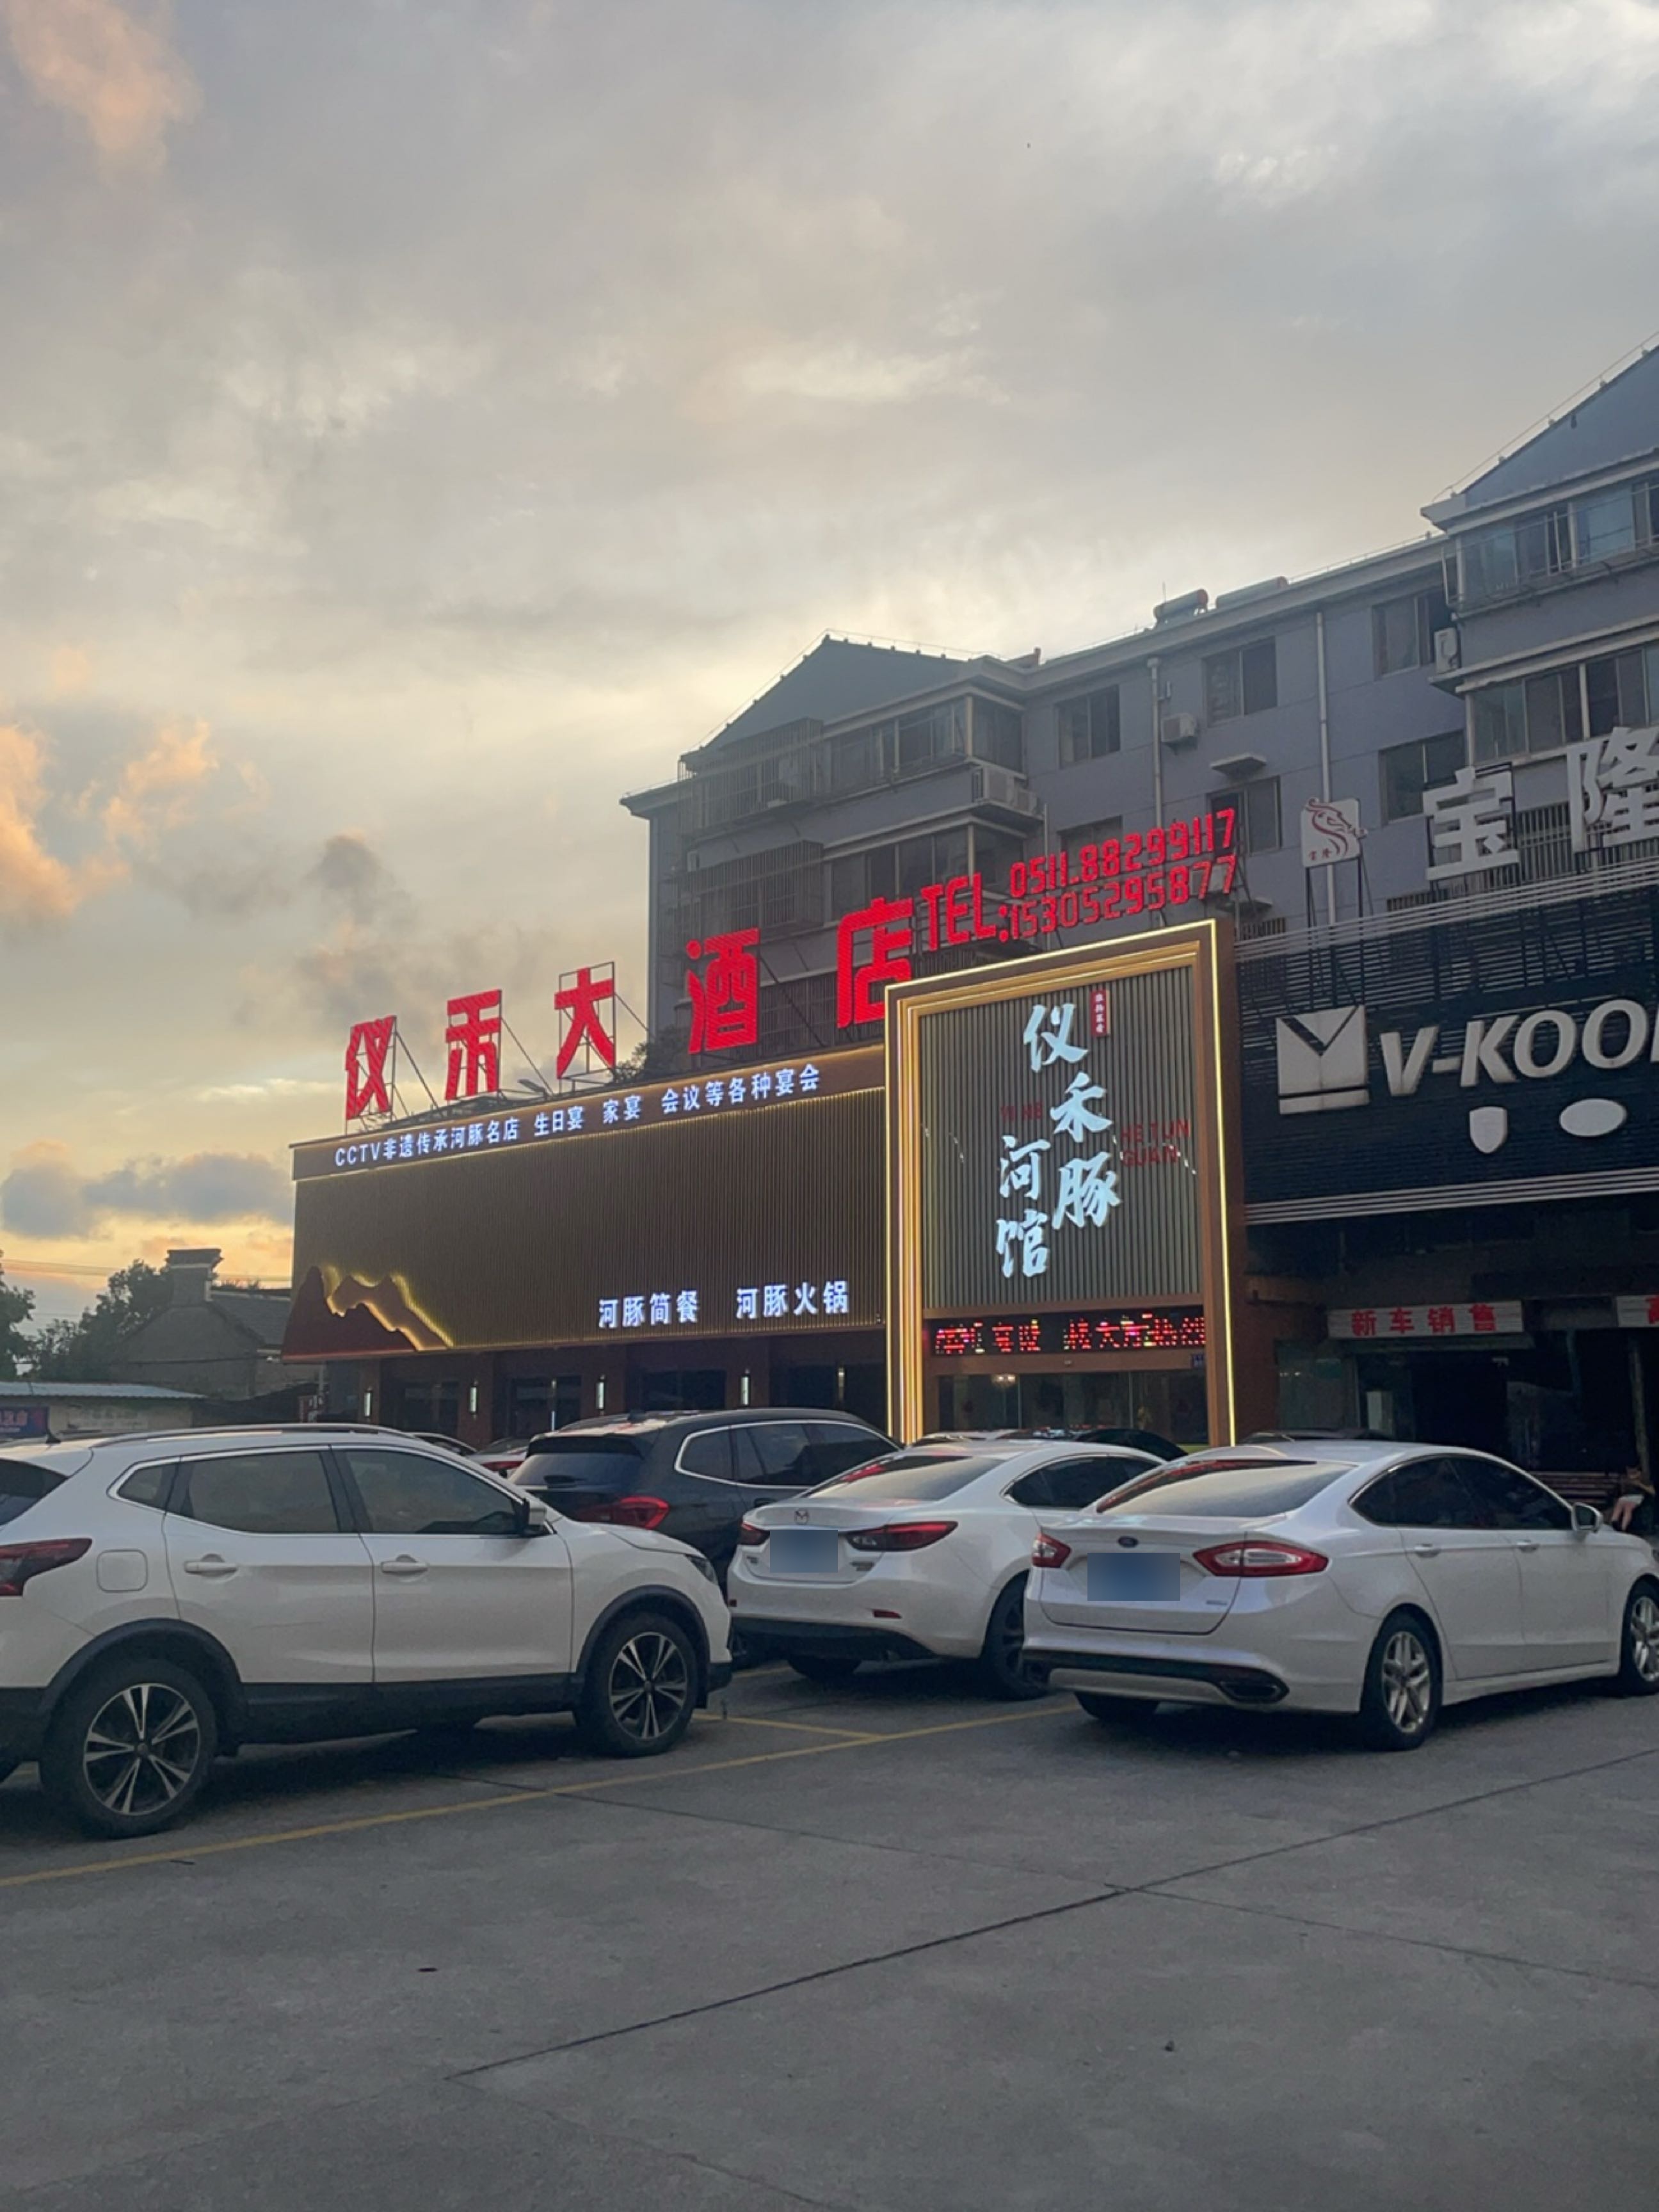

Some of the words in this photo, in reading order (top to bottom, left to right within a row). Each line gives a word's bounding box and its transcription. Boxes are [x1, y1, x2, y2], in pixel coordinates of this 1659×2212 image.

[1422, 726, 1659, 881] 宝隆
[920, 872, 1009, 952] TEL:
[1010, 854, 1236, 940] 15305295877
[346, 897, 913, 1120] 仪禾大酒店
[1380, 999, 1659, 1096] V-KOO
[534, 1105, 584, 1137] 生日宴
[603, 1095, 642, 1125] 家宴
[661, 1063, 820, 1114] 会议等各种宴会
[598, 1290, 700, 1329] 河豚简餐
[736, 1280, 850, 1320] 河豚火锅
[1351, 1302, 1496, 1336] 新车销售
